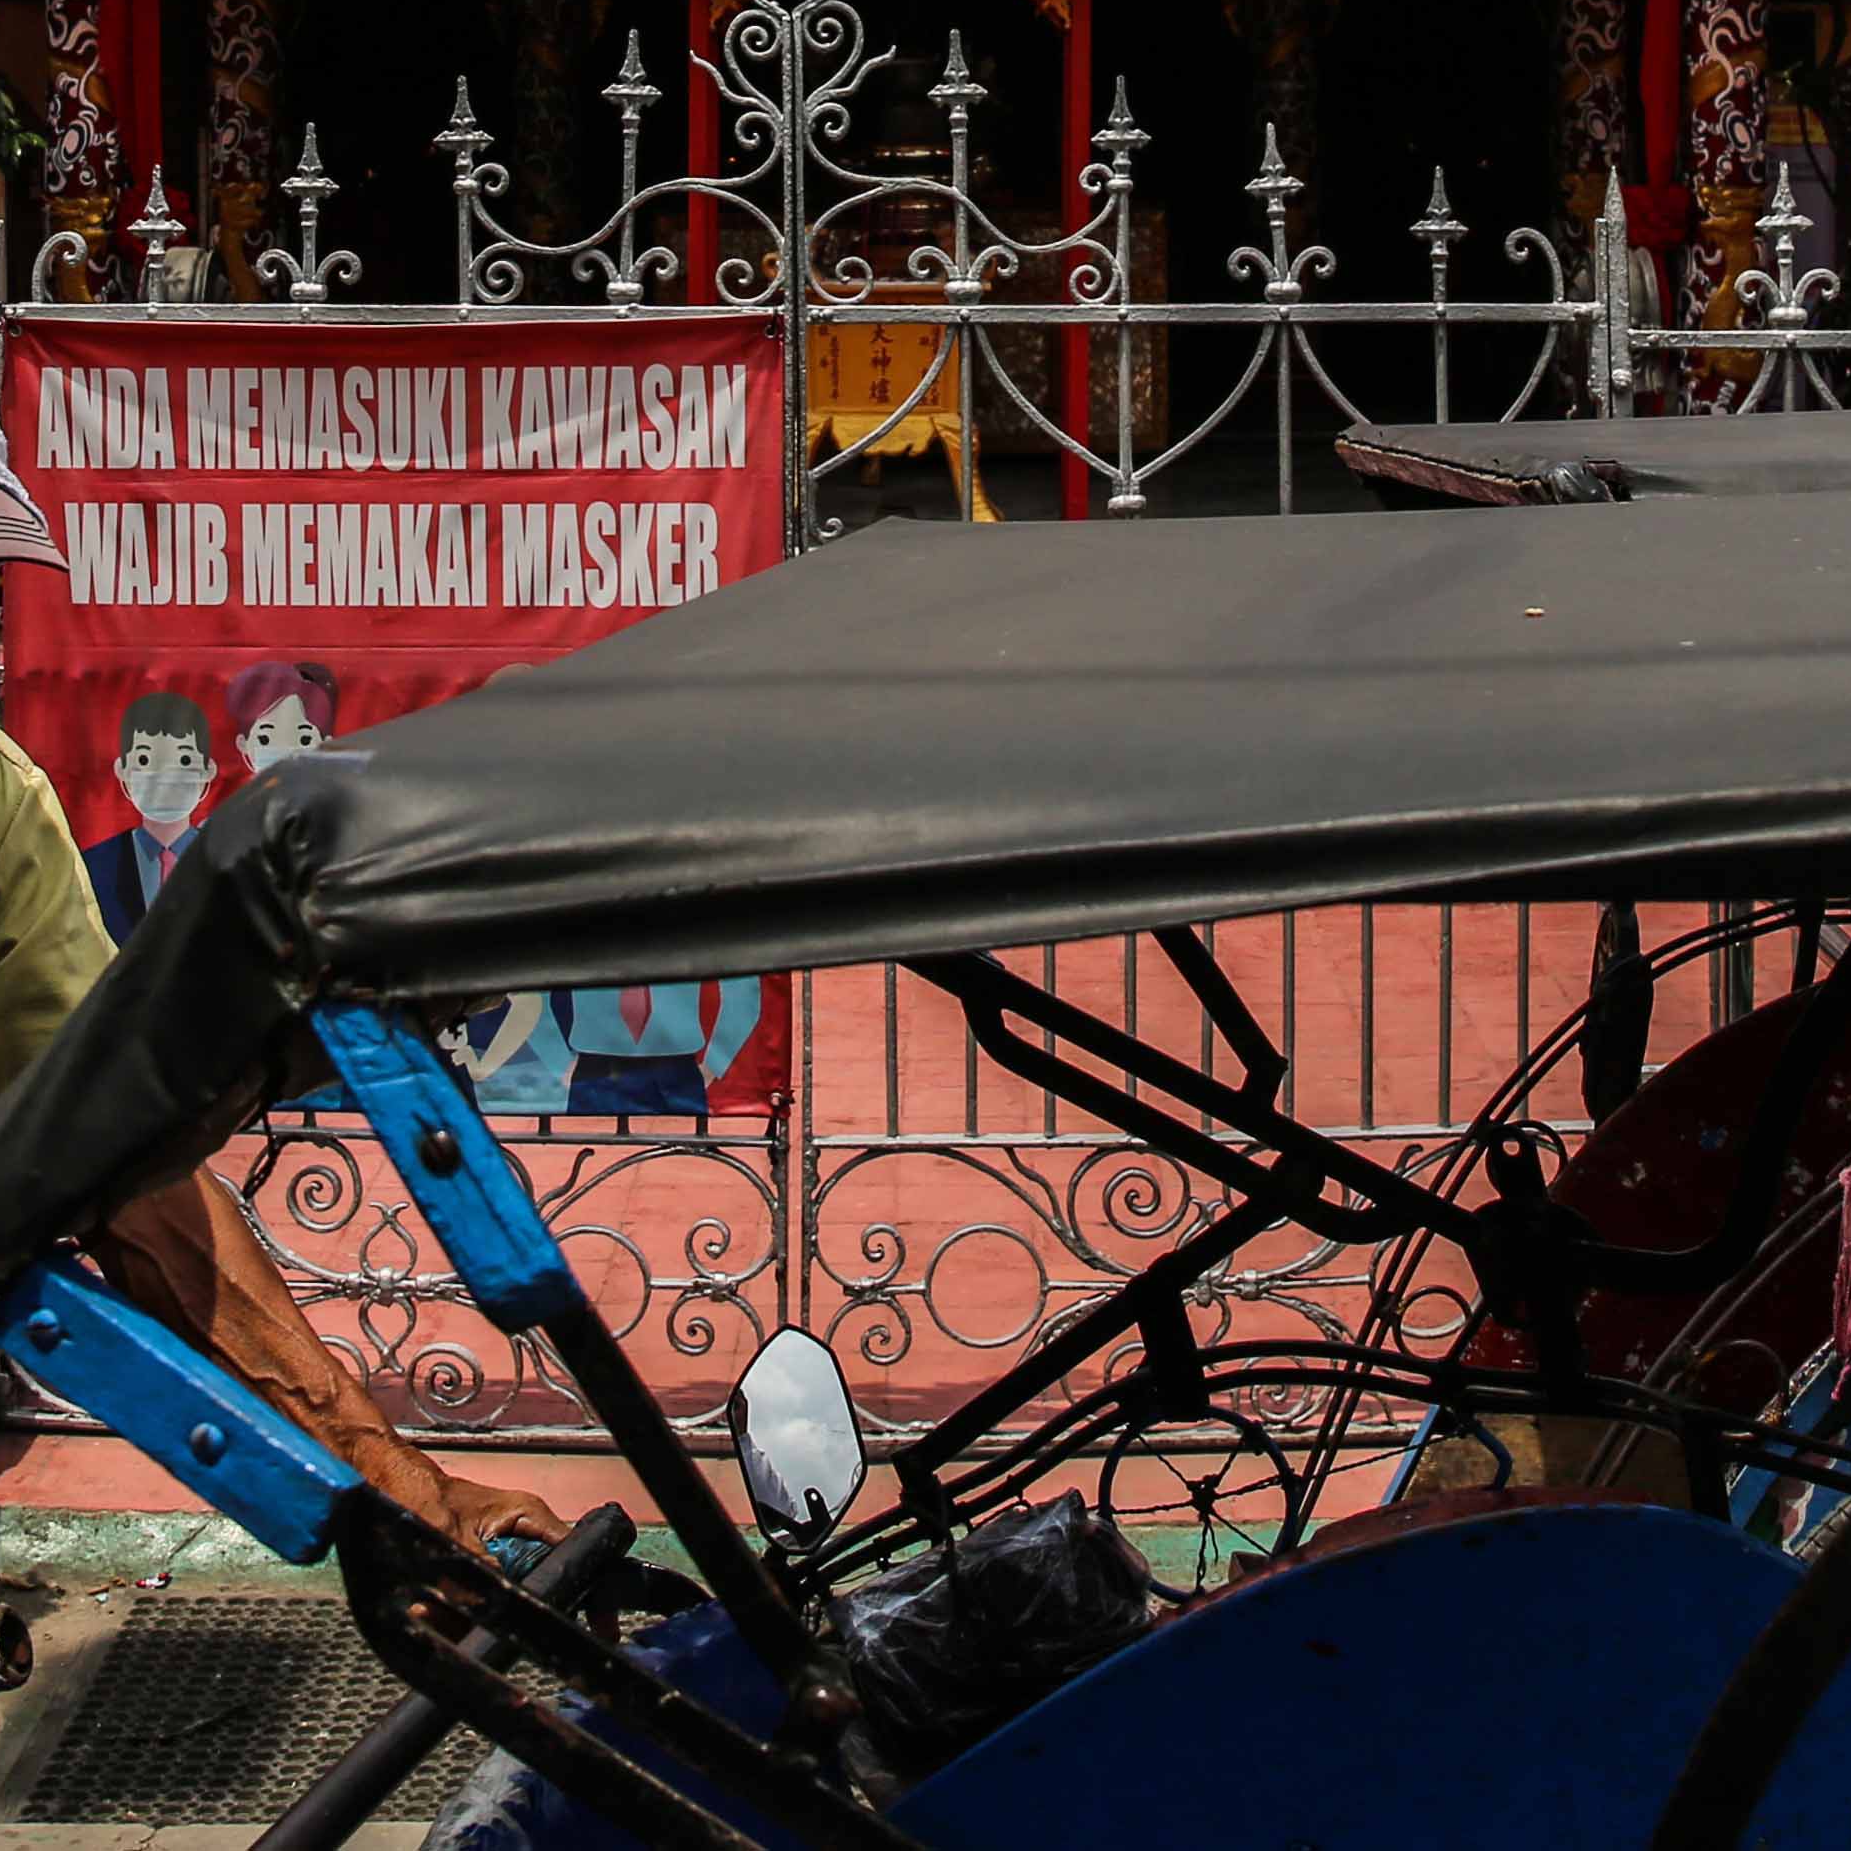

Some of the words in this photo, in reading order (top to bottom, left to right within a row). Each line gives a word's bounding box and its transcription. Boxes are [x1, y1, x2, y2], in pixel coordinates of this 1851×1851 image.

[36, 366, 177, 471] ANDA
[186, 365, 468, 473] MEMASUKI
[480, 363, 748, 471] KAWASAN
[63, 502, 229, 607] WAJIB
[241, 502, 488, 608] MEMAKAI
[501, 500, 720, 609] MASKER
